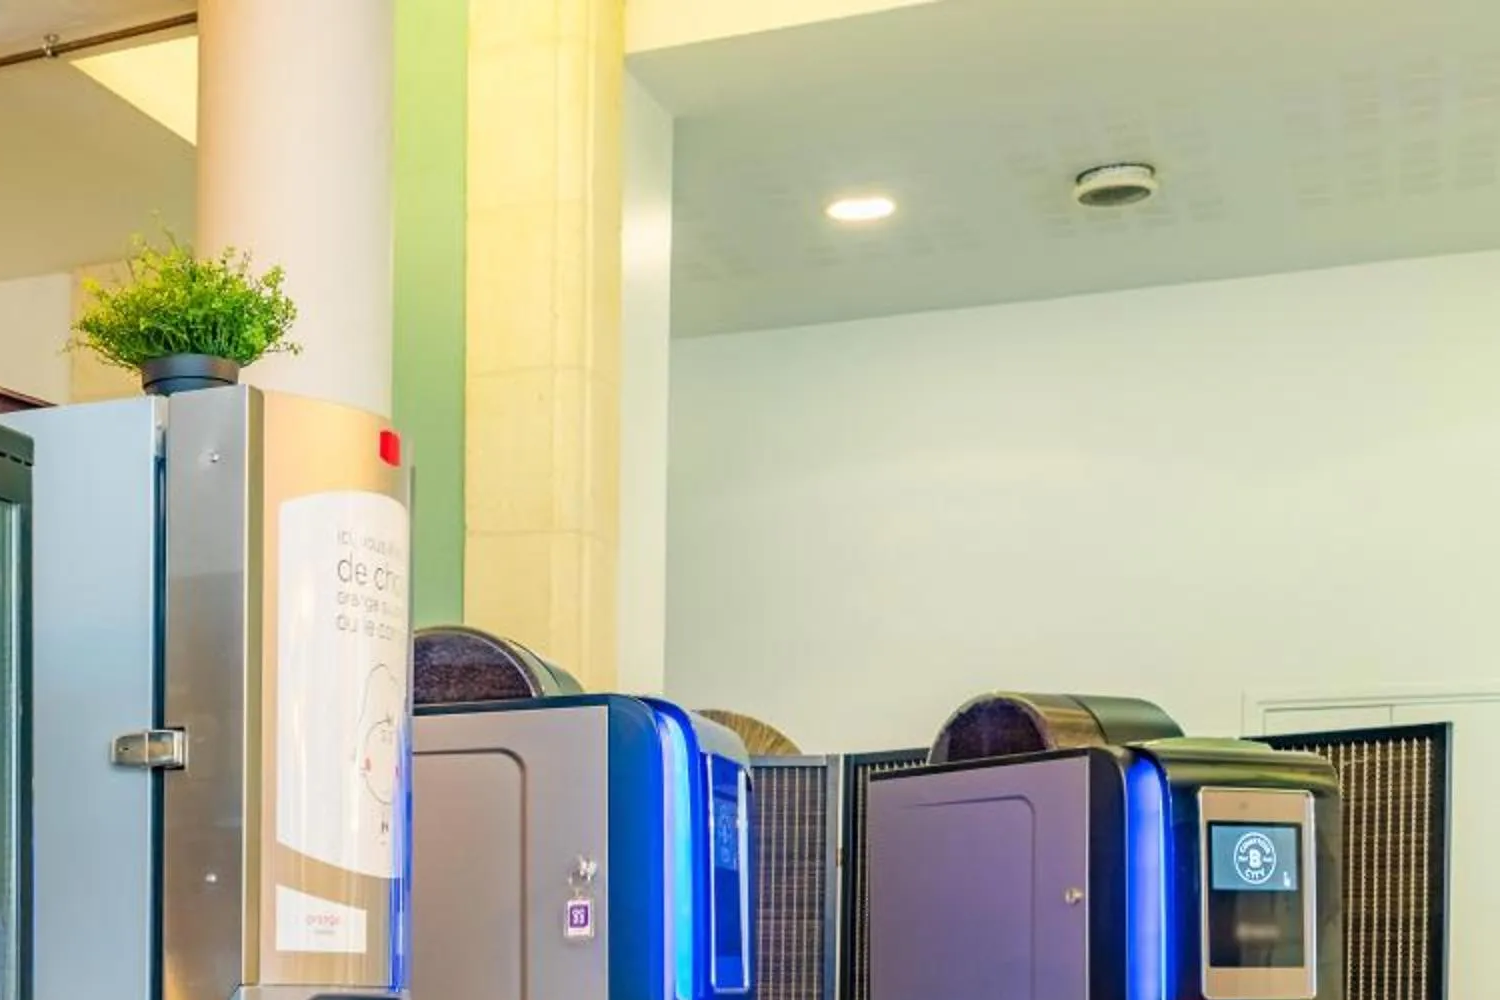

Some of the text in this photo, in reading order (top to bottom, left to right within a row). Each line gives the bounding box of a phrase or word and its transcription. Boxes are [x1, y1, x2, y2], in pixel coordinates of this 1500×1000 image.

[337, 551, 368, 586] de
[1249, 848, 1262, 868] B
[1245, 868, 1266, 880] CITY
